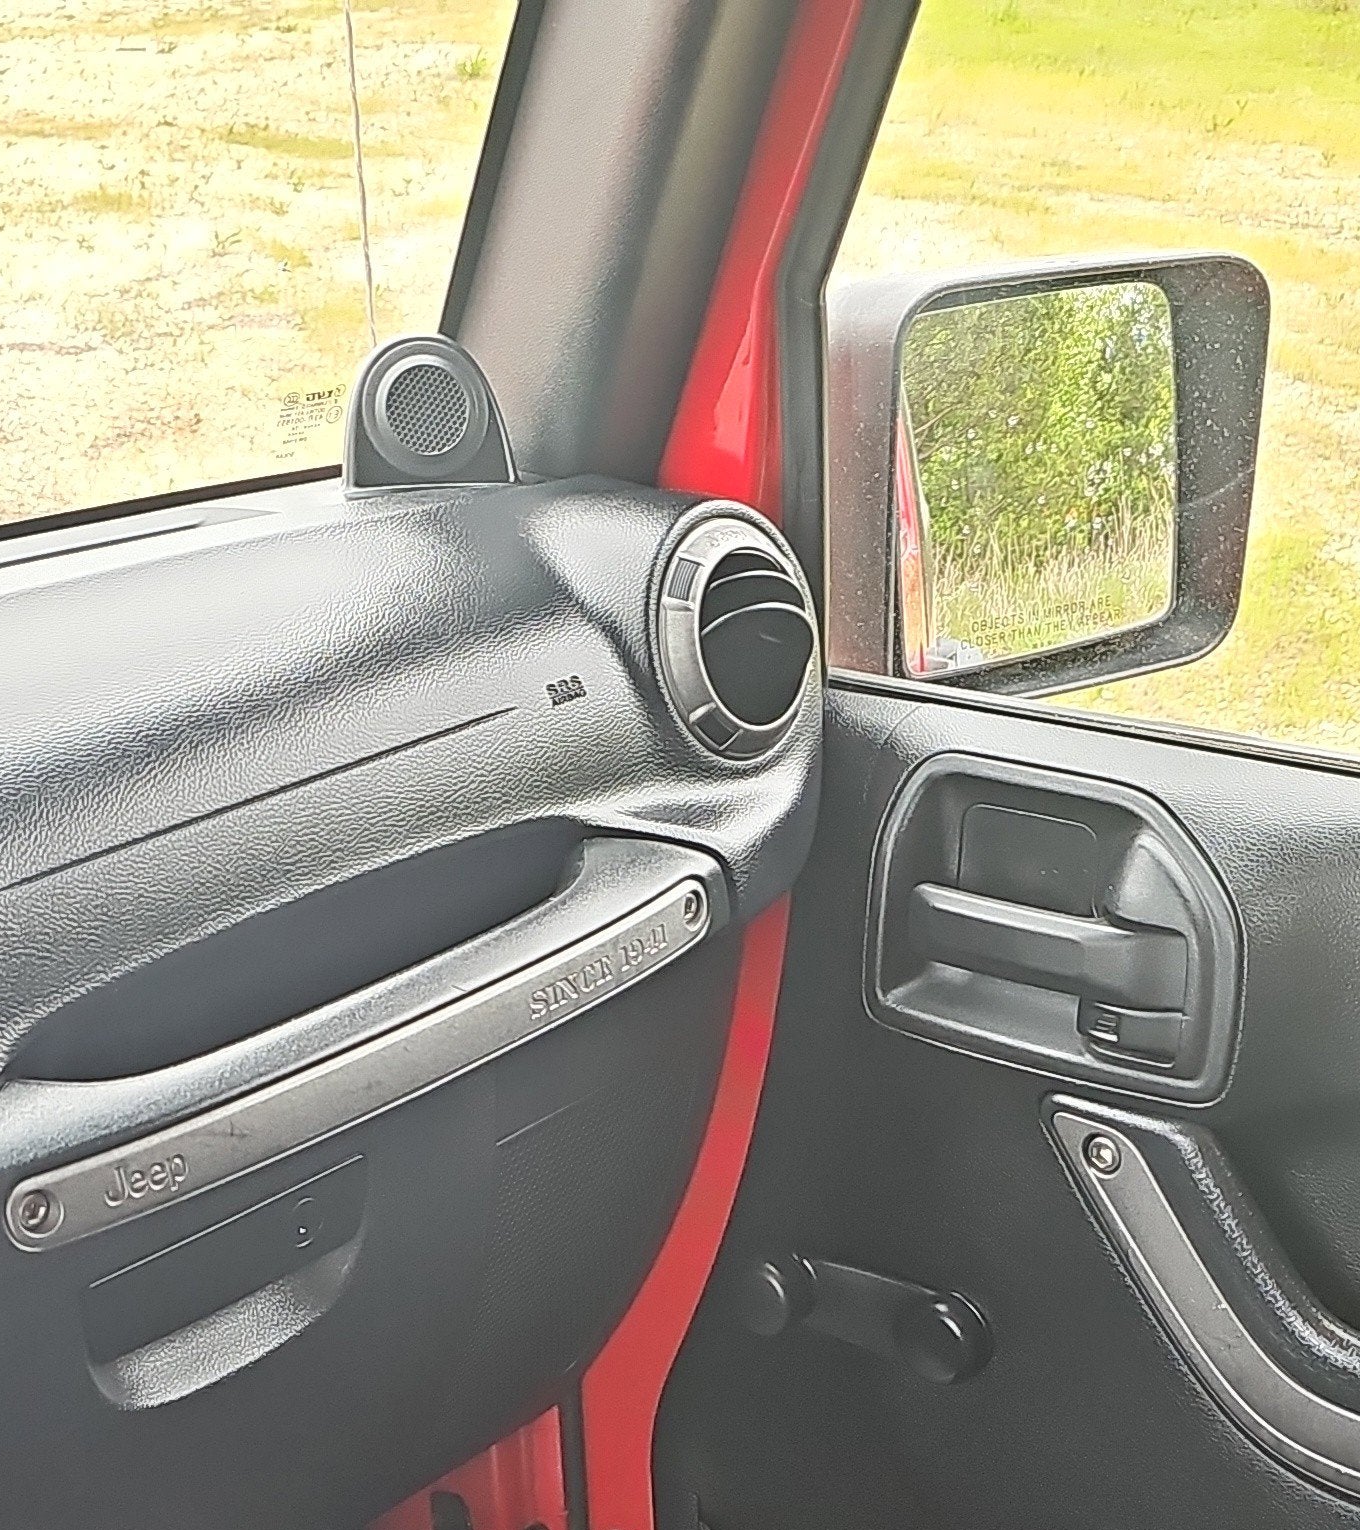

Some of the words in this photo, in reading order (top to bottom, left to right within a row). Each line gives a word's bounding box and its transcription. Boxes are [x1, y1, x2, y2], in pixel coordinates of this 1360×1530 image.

[972, 613, 1024, 632] OBJECTS
[1090, 595, 1112, 610] ARE
[960, 632, 1011, 650] CLOSER
[1011, 627, 1040, 642] THAN
[1045, 617, 1074, 633] THEY
[545, 675, 584, 699] SRS
[104, 1153, 188, 1209] Jeep
[529, 955, 614, 1021] SINCE
[619, 922, 669, 972] 1941
